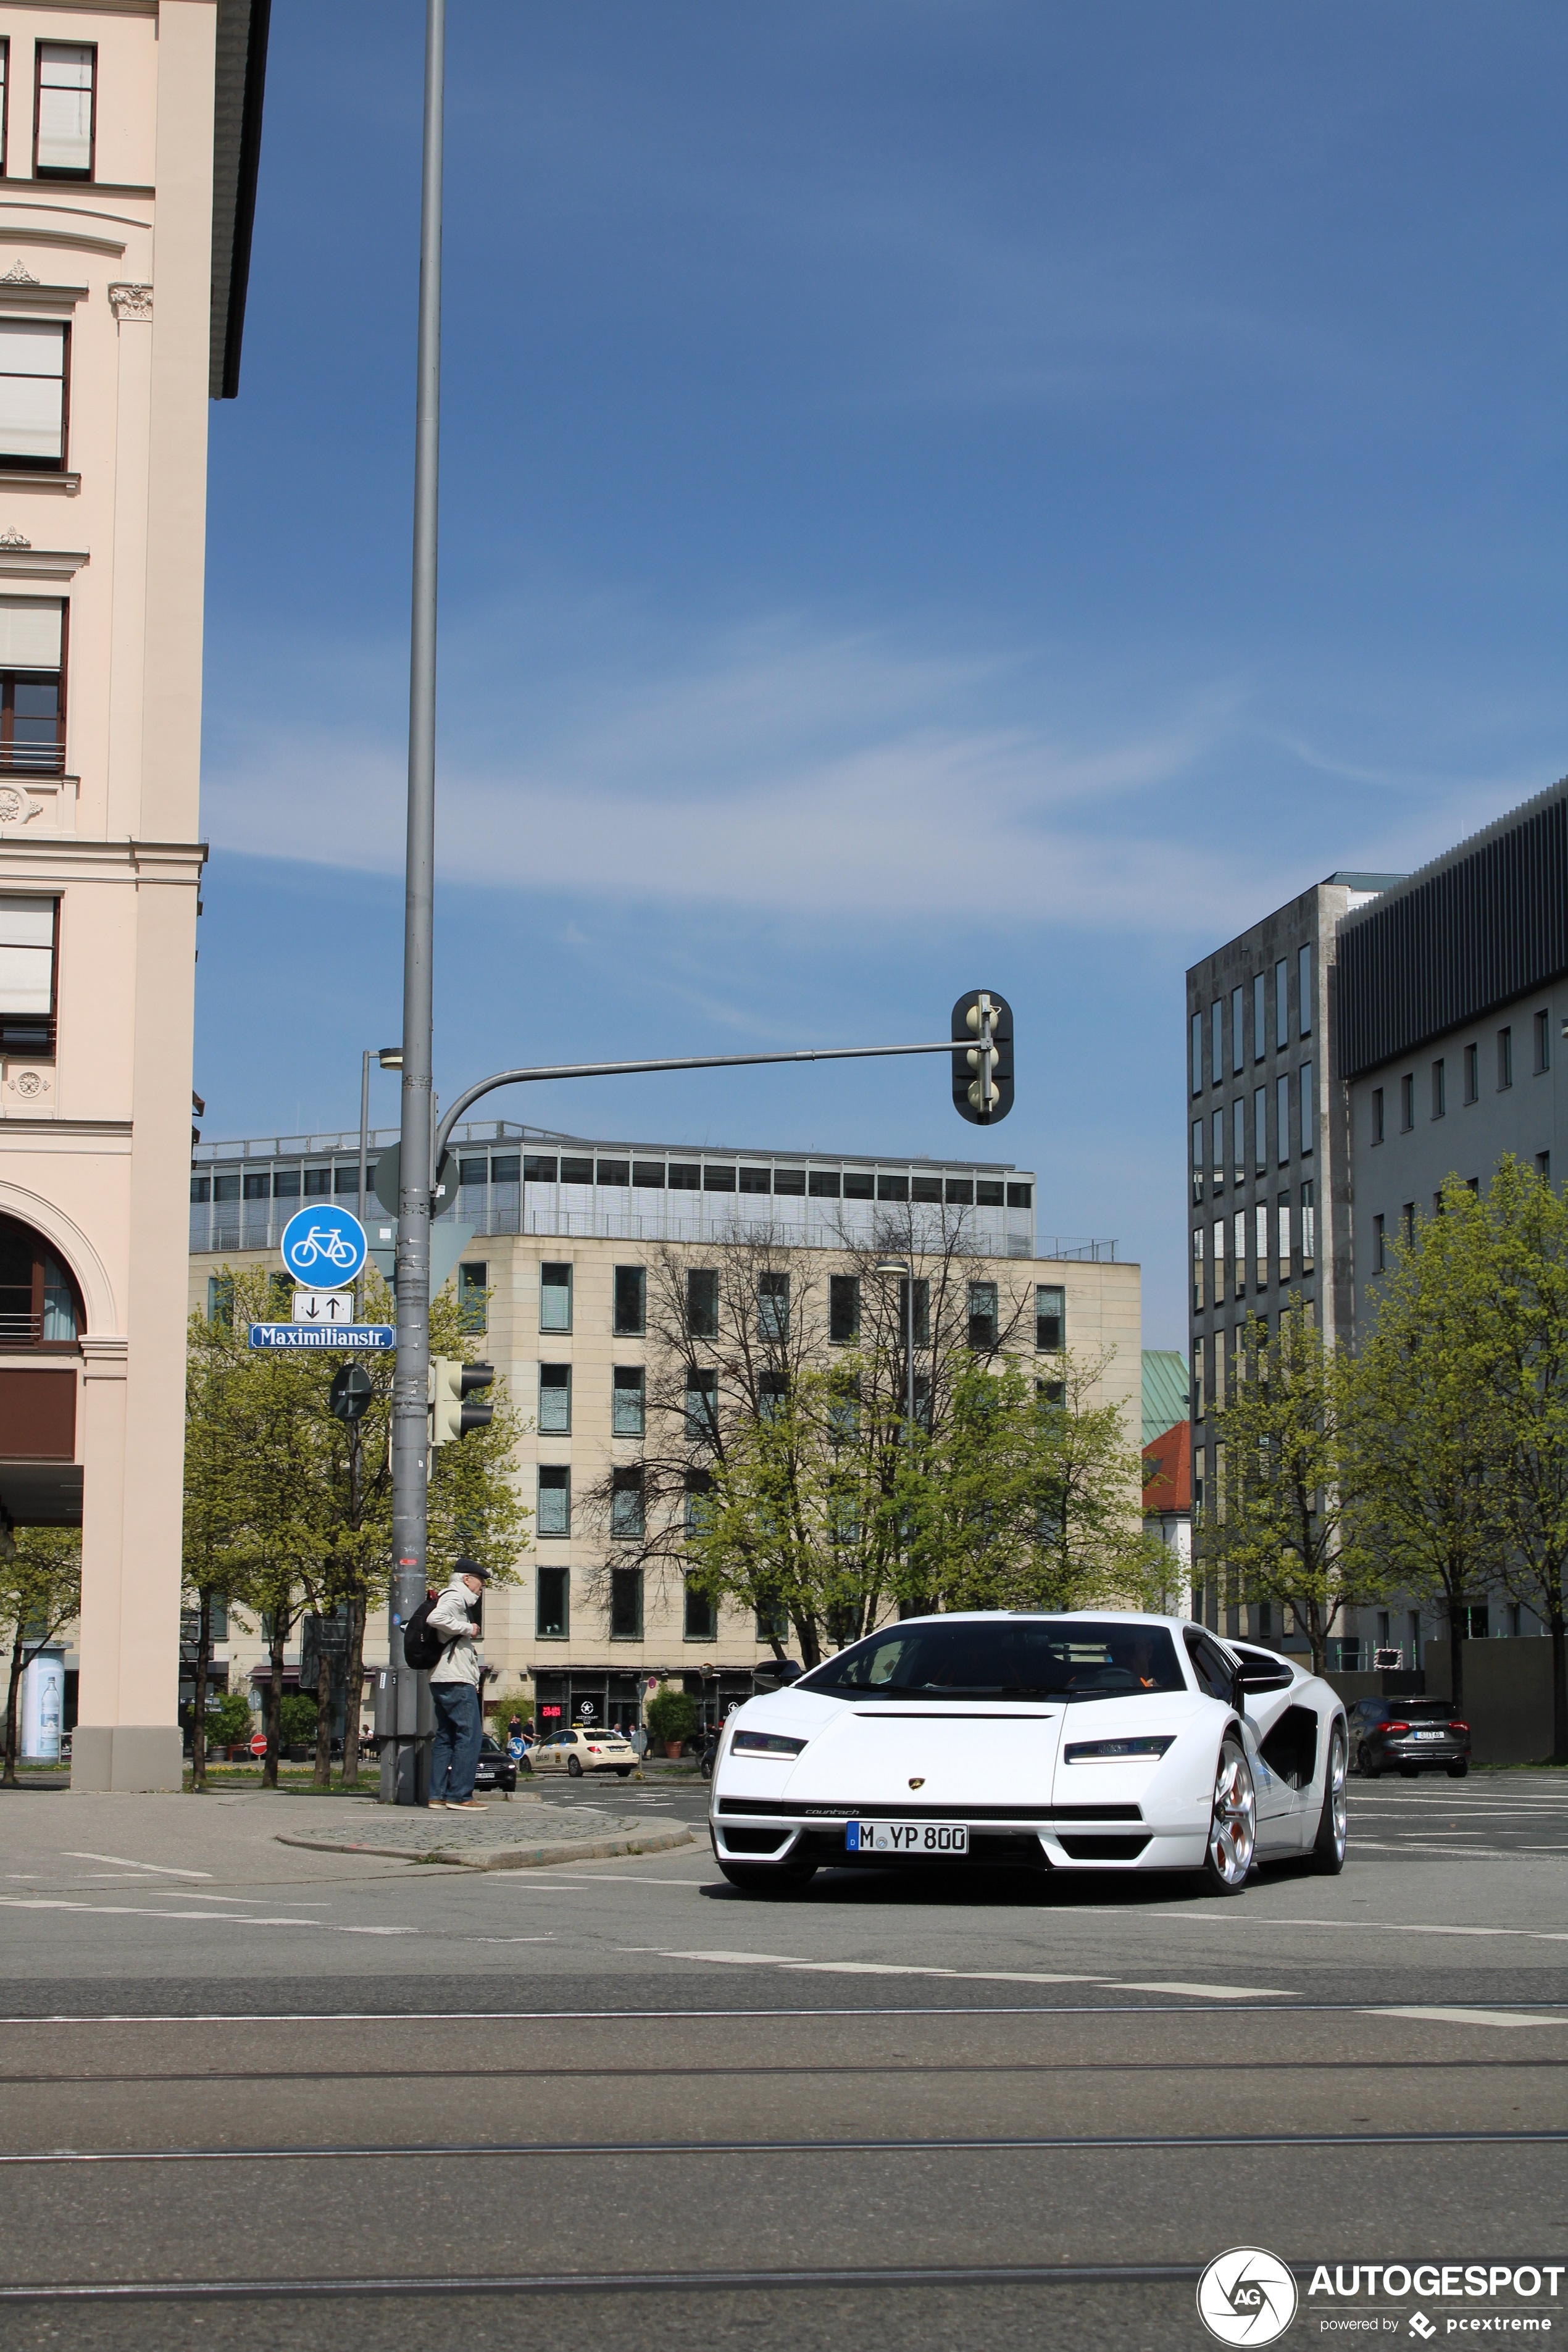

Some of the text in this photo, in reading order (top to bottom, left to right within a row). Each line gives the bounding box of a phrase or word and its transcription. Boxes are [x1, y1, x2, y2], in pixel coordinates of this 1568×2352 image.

[261, 1328, 385, 1346] Maximilianstr.
[860, 1825, 874, 1848] M
[890, 1826, 918, 1848] YP
[924, 1827, 965, 1850] 800
